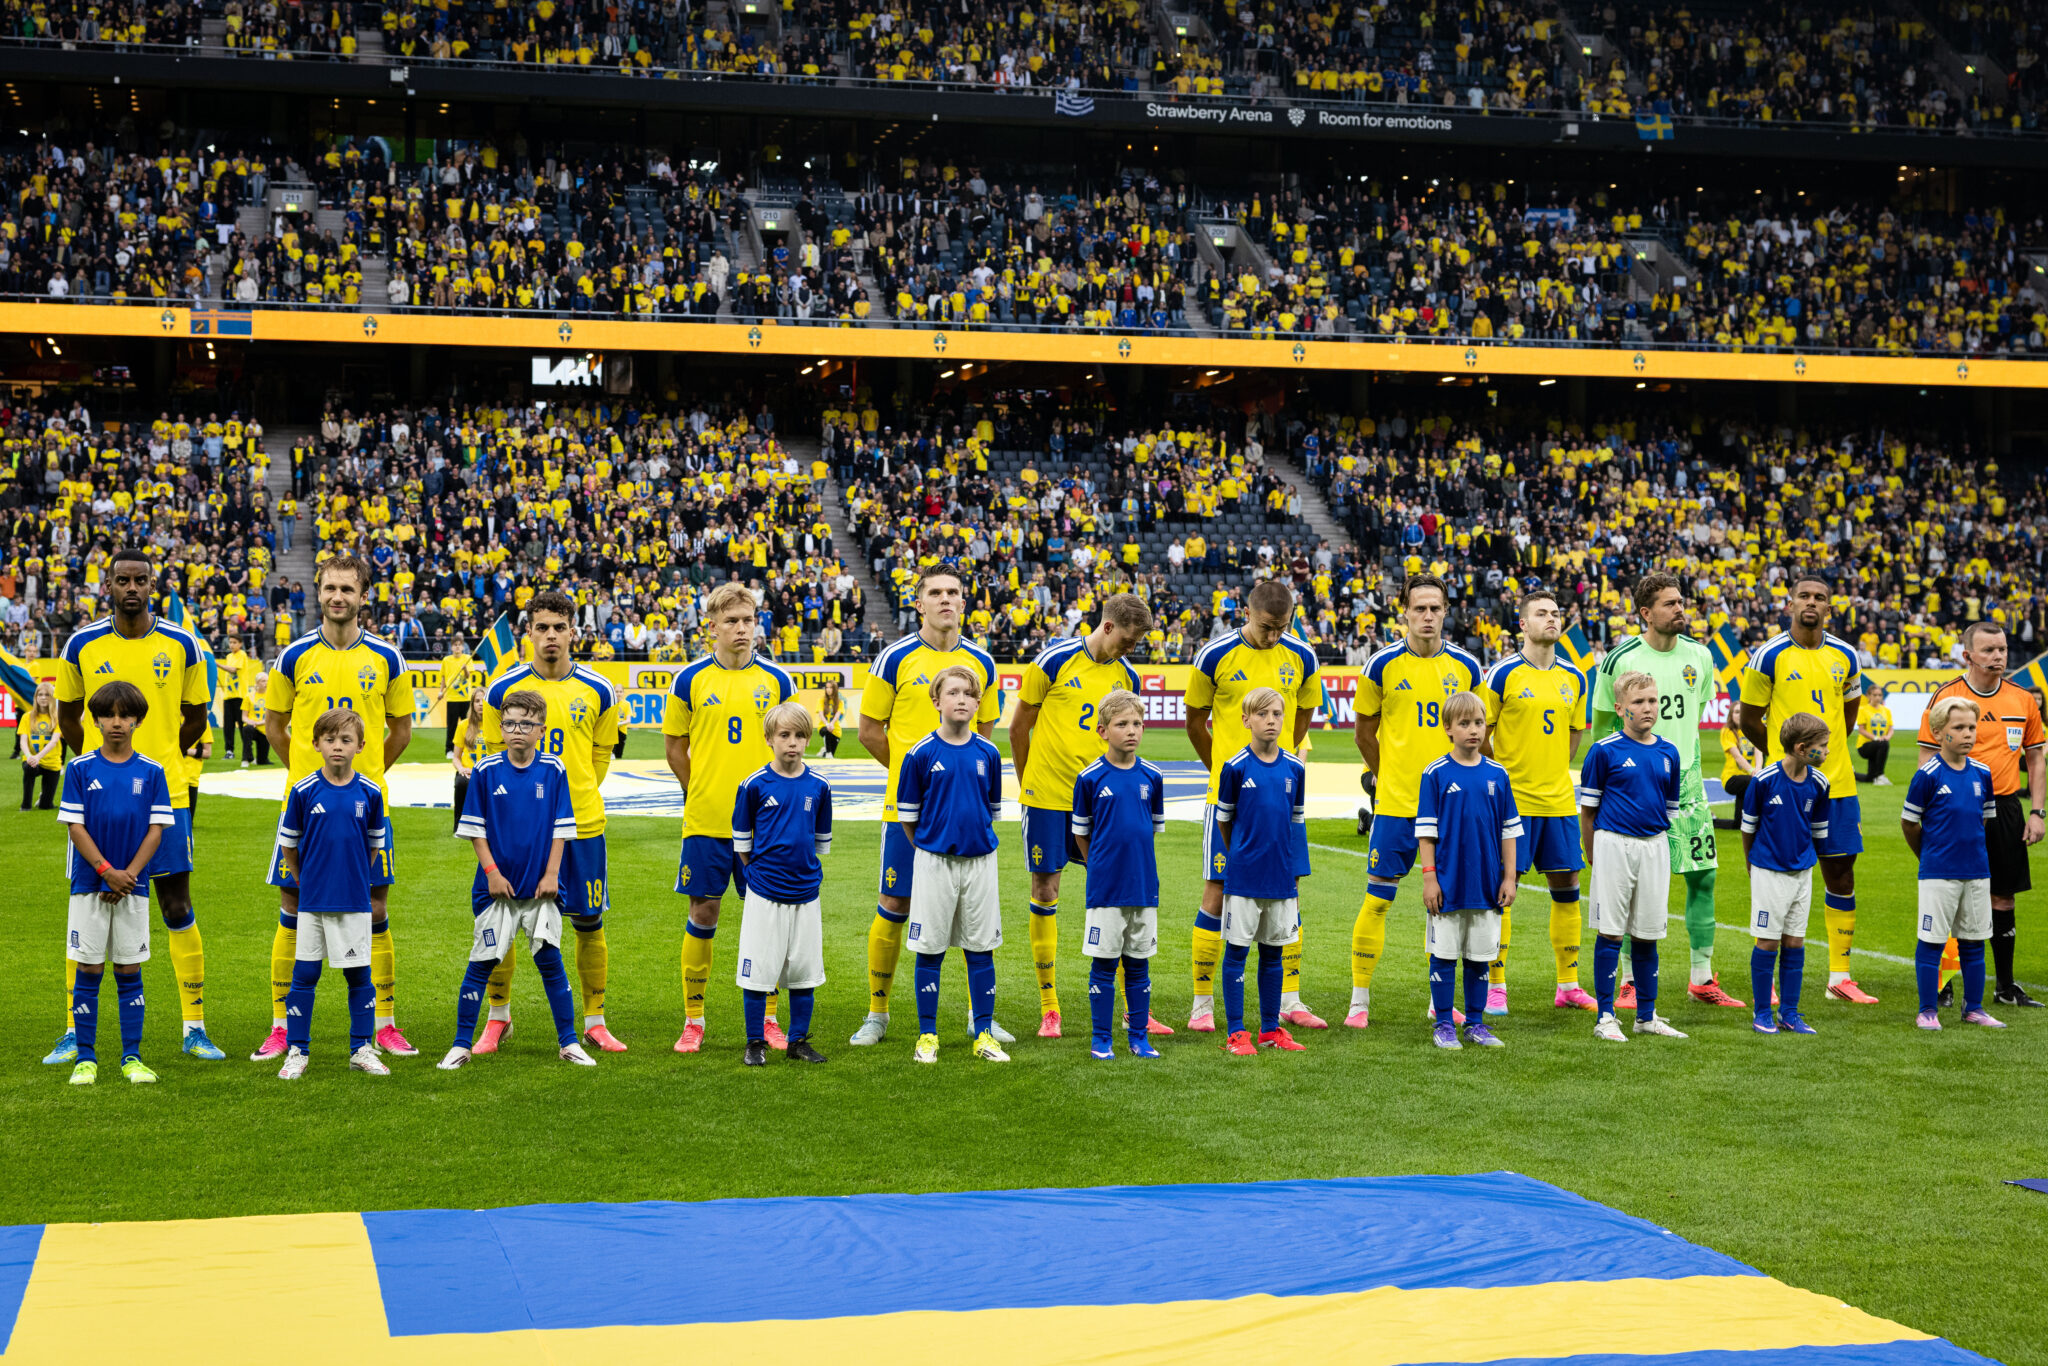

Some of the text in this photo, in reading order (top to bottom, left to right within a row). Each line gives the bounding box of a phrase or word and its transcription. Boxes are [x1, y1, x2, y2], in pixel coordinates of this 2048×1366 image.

[1146, 102, 1273, 123] Strawberry Arena
[1318, 110, 1452, 130] Room for emotions
[1416, 701, 1439, 728] 19
[1660, 694, 1684, 720] 23
[1811, 689, 1825, 714] 4
[727, 716, 743, 744] 8
[1543, 709, 1555, 735] 5
[1690, 834, 1716, 861] 23
[585, 877, 601, 905] 18
